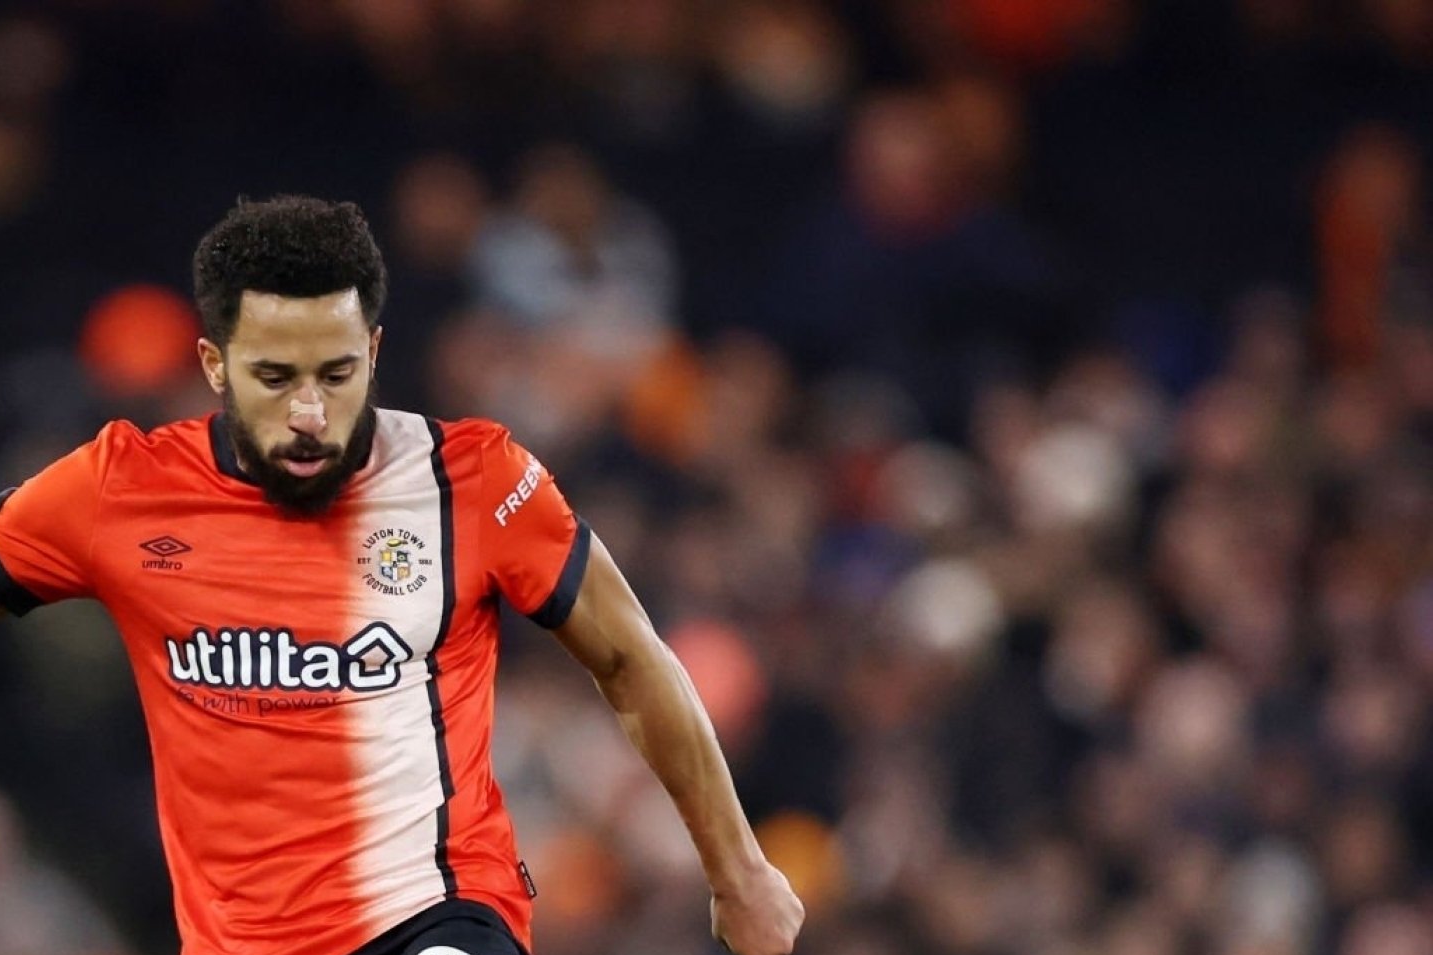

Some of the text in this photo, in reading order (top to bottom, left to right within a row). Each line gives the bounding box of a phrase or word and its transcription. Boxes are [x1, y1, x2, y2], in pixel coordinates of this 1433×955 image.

[362, 528, 426, 549] LUTON TOWN
[142, 557, 183, 571] umbro
[362, 573, 428, 596] FOOTBALL CLUB
[166, 629, 342, 690] utilita
[203, 690, 250, 715] with
